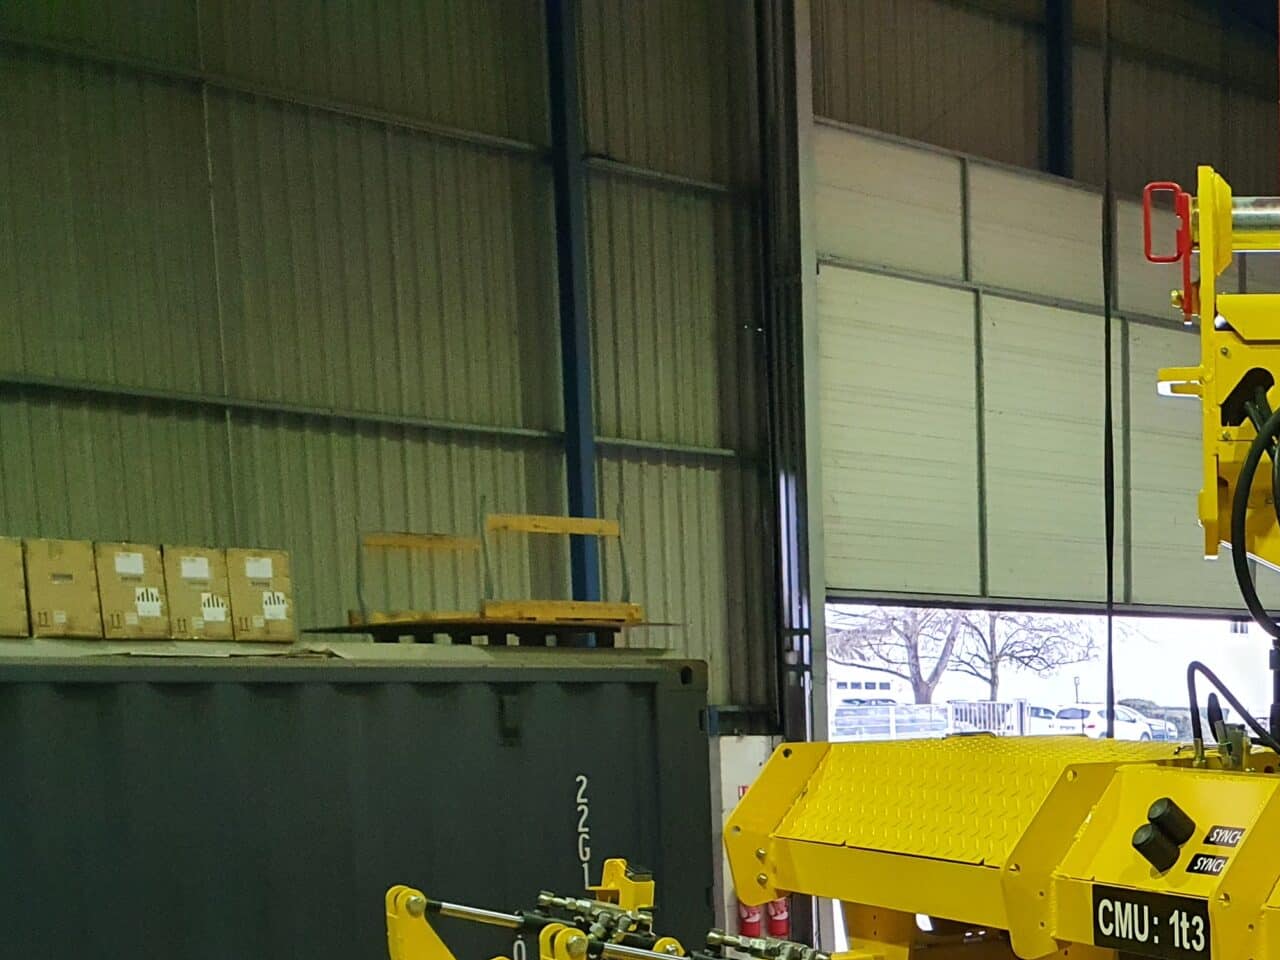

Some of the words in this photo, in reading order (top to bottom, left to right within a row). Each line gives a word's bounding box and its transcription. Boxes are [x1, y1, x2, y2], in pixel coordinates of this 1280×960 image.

[575, 775, 591, 889] 22G1
[1098, 898, 1159, 943] CMU:
[1169, 909, 1205, 952] 1t3
